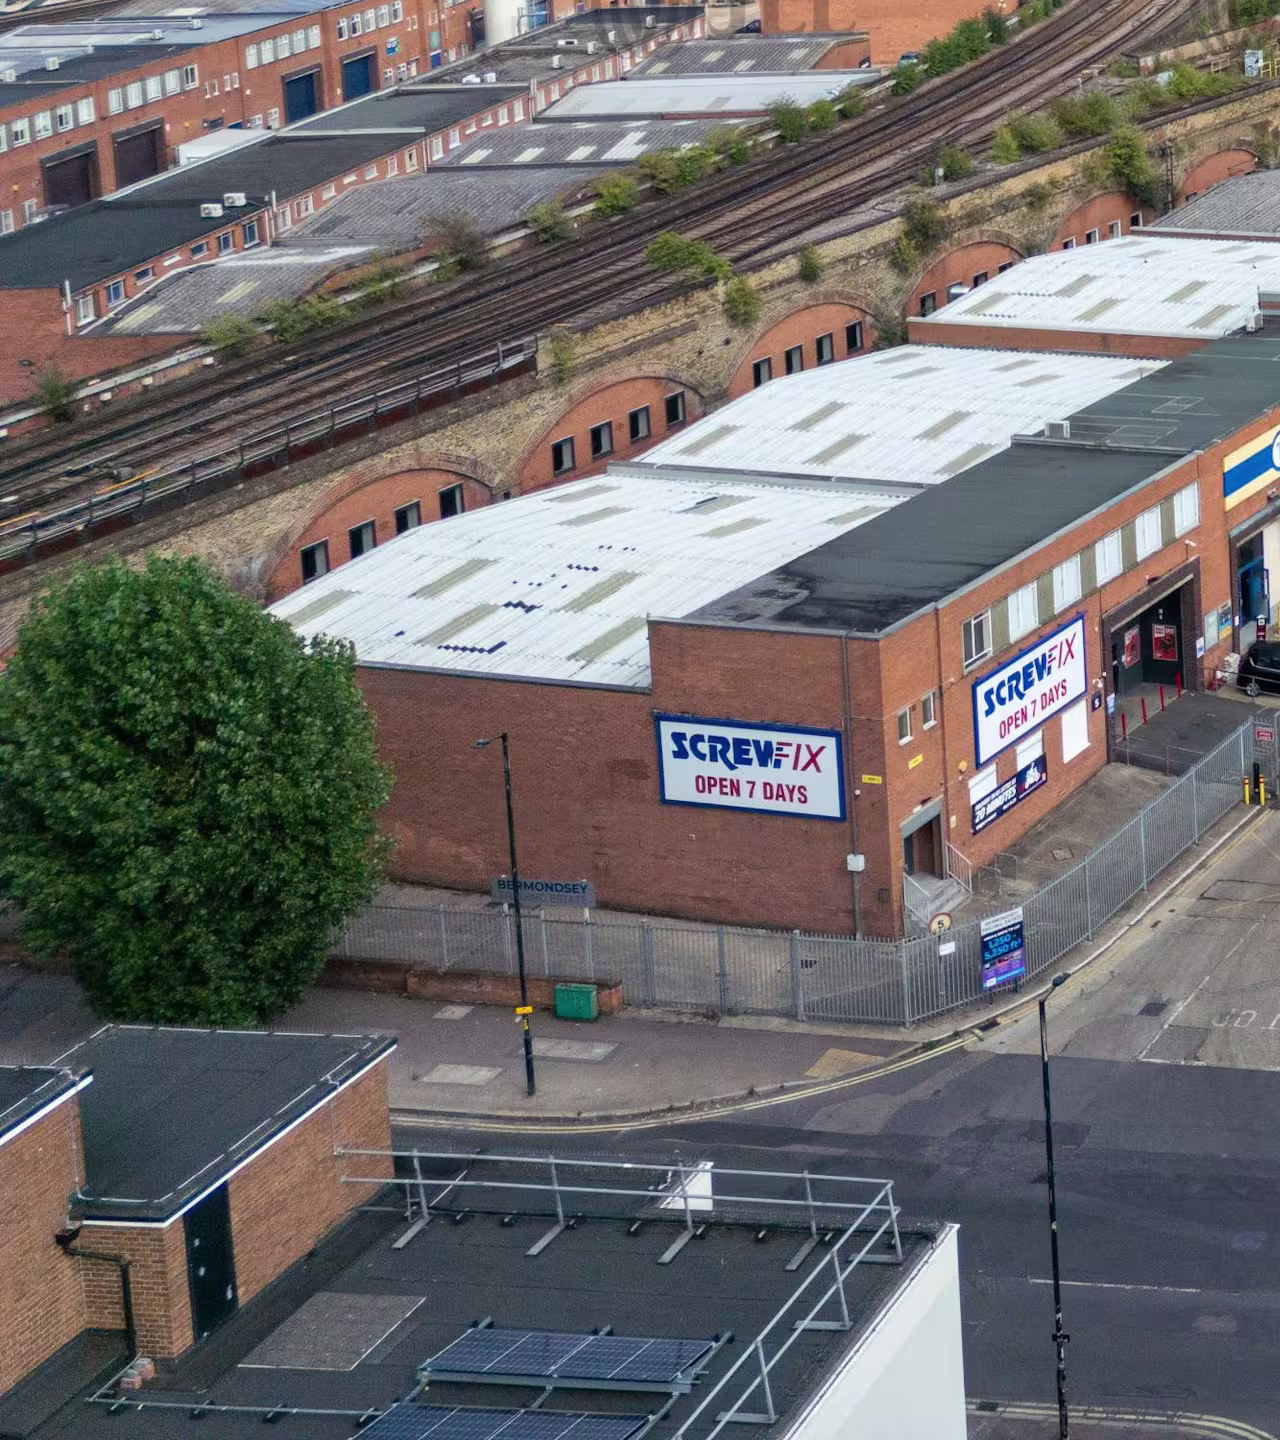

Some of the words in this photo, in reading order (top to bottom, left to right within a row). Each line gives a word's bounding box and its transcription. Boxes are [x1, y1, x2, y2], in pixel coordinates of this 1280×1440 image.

[984, 632, 1077, 718] SCREWFIX
[999, 705, 1028, 739] OPEN
[1031, 699, 1037, 718] 7
[1041, 679, 1067, 711] DAYS
[671, 731, 826, 773] SCREWFIX
[695, 774, 741, 797] OPEN
[746, 780, 756, 798] 7
[763, 782, 808, 804] DAYS
[975, 806, 986, 823] 20
[986, 785, 1017, 815] MINUTES
[497, 880, 588, 894] BERMONDSEY
[937, 919, 944, 928] 5
[984, 944, 1009, 960] 5,250
[988, 934, 1010, 948] 1,250
